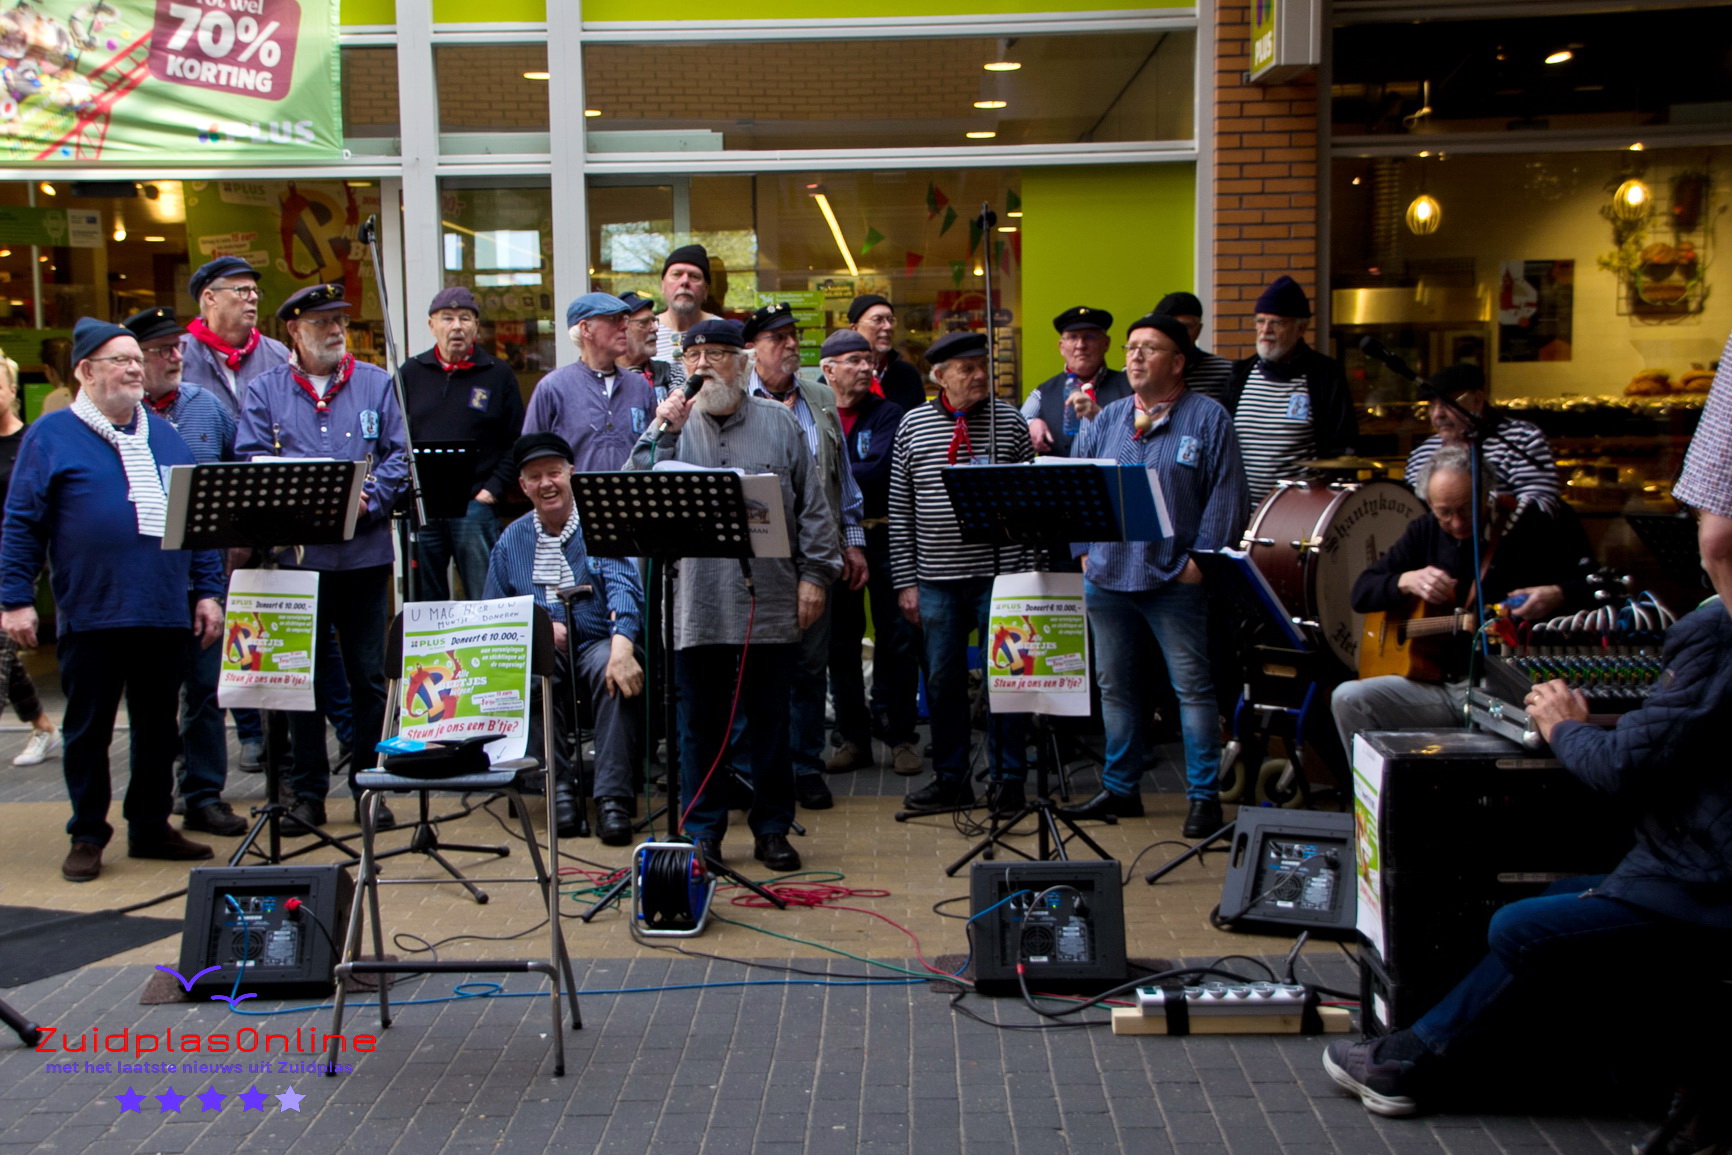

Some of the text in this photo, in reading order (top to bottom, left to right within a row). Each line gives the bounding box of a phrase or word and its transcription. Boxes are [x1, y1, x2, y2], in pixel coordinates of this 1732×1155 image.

[229, 0, 264, 14] wel
[166, 3, 281, 68] 70%
[1255, 30, 1272, 67] PLUS
[166, 54, 273, 93] KORTING
[226, 120, 316, 143] PLUS
[411, 608, 420, 621] U
[429, 607, 454, 620] MAG
[420, 638, 446, 647] PLUS
[450, 632, 525, 646] Doneert € 10.000,-
[994, 678, 1016, 688] Steun
[1017, 678, 1025, 689] je
[407, 720, 519, 738] Steun je ons een B'tje?
